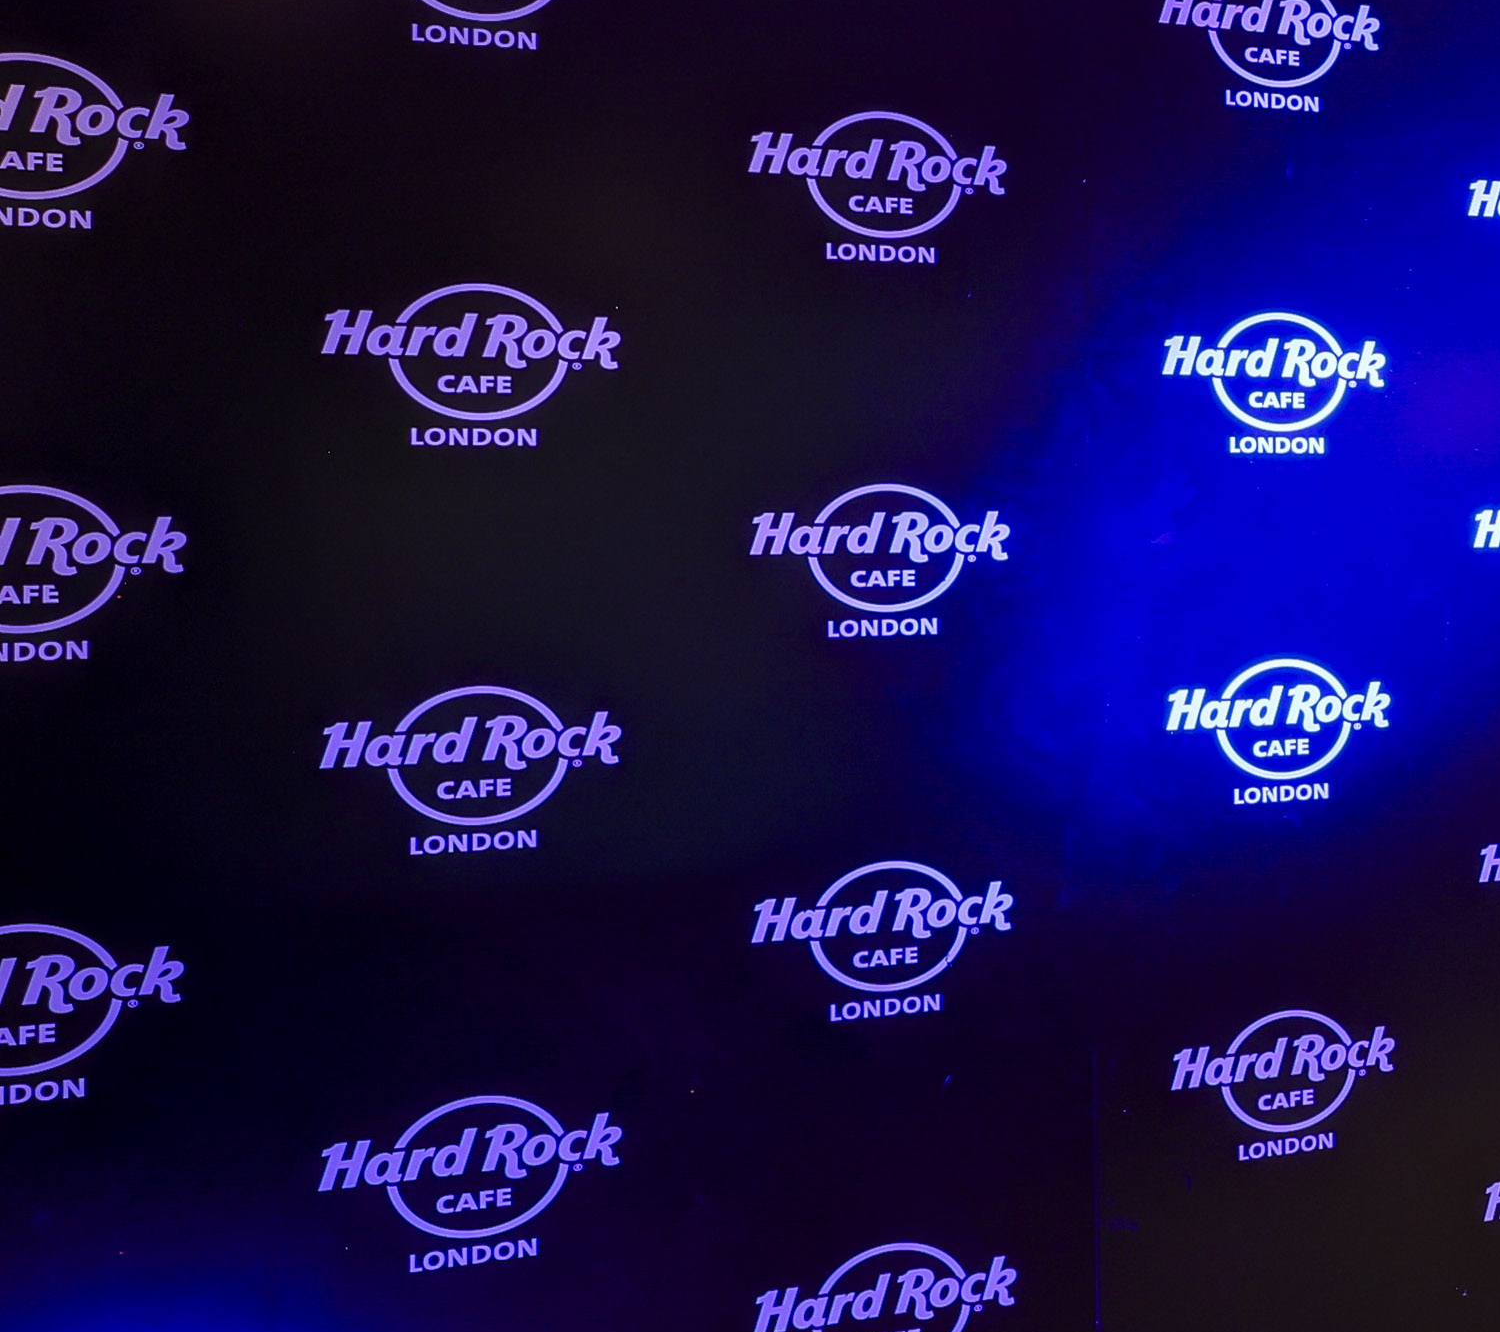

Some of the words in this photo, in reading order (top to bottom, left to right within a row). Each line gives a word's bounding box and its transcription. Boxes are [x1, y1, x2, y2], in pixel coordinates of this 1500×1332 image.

[410, 22, 537, 51] LONDON
[1244, 45, 1300, 67] CAFE
[1224, 89, 1320, 113] LONDON
[28, 85, 190, 151] Rock
[0, 150, 64, 172] AFE
[747, 131, 884, 179] Hard
[886, 139, 1008, 196] Rock
[848, 194, 914, 215] CAFE
[825, 242, 935, 264] LONDON
[320, 309, 479, 357] Hard
[480, 313, 621, 370] Rock
[1161, 335, 1280, 377] Hard
[1280, 338, 1386, 388] Rock
[436, 373, 512, 394] CAFE
[1248, 391, 1305, 409] CAFE
[410, 427, 537, 447] LONDON
[1229, 436, 1324, 454] LONDON
[24, 515, 187, 577] Rock
[748, 510, 887, 556] Hard
[888, 510, 1011, 563] Rock
[850, 568, 916, 588] CAFE
[0, 584, 60, 605] AFE
[827, 617, 938, 638] LONDON
[1165, 684, 1284, 731] Hard
[1285, 680, 1391, 733] Rock
[318, 715, 478, 770] Hard
[480, 710, 622, 771] Rock
[1252, 737, 1310, 757] CAFE
[436, 777, 512, 800] CAFE
[1233, 782, 1329, 805] LONDON
[409, 829, 537, 856] LONDON
[750, 889, 889, 944] Hard
[890, 880, 1014, 940] Rock
[852, 945, 919, 969] CAFE
[20, 944, 184, 1015] Rock
[829, 993, 941, 1022] LONDON
[0, 1022, 56, 1046] AFE
[1170, 1036, 1289, 1091] Hard
[1290, 1024, 1396, 1083] Rock
[0, 1077, 86, 1107] DON
[1257, 1087, 1314, 1111] CAFE
[317, 1126, 478, 1193] Hard
[480, 1111, 623, 1180] Rock
[1238, 1131, 1334, 1162] LONDON
[435, 1186, 512, 1214] CAFE
[408, 1237, 538, 1273] LONDON
[893, 1255, 1017, 1321] Rock
